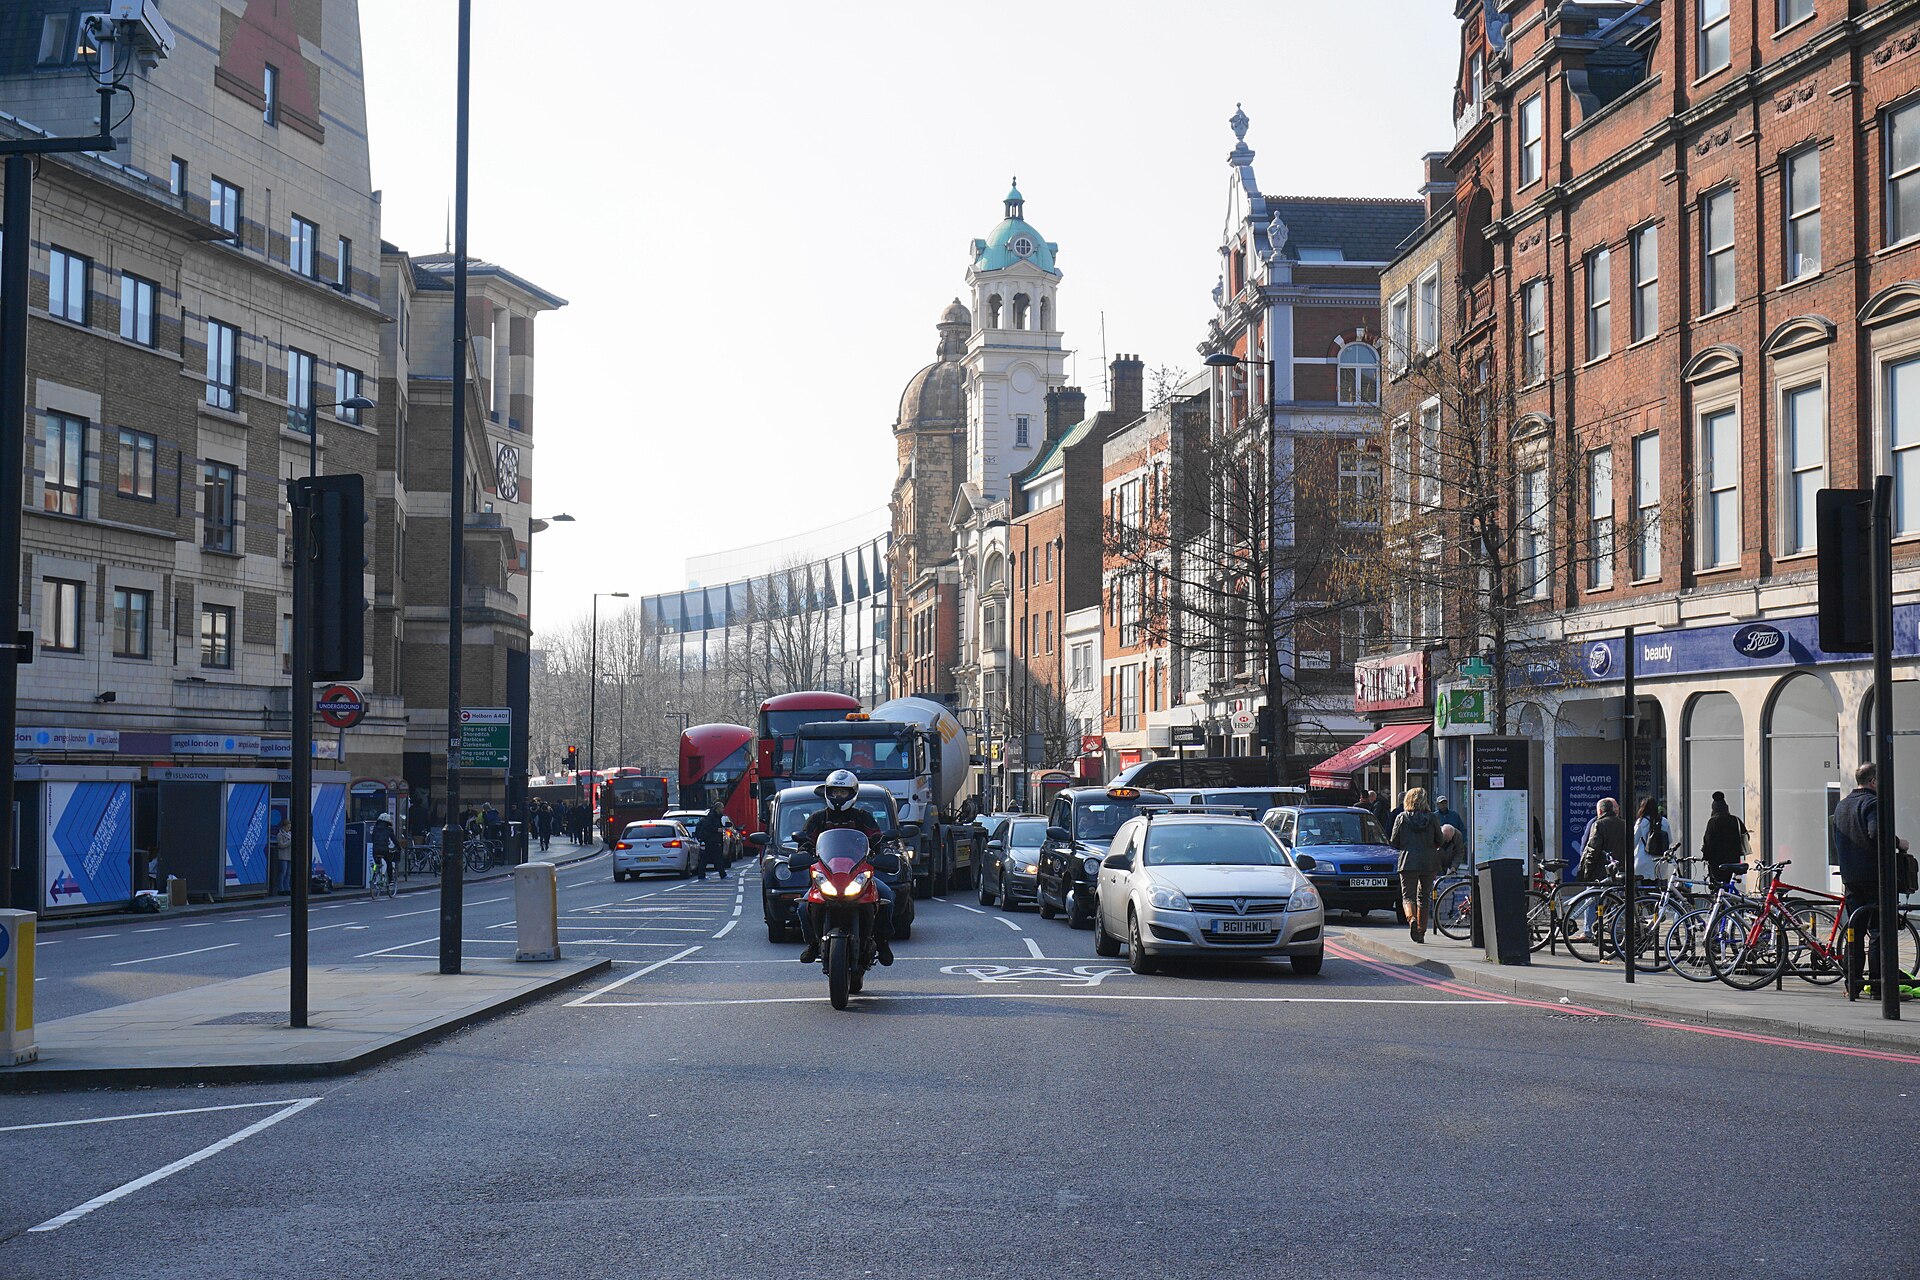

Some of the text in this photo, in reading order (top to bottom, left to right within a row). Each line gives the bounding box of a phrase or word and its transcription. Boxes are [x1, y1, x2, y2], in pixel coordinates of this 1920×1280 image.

[1743, 631, 1779, 651] Boots
[1644, 643, 1672, 663] beauty
[714, 772, 727, 782] 73
[1570, 773, 1612, 783] welcome
[107, 790, 127, 829] BUSINESS
[82, 842, 97, 868] UPPER
[94, 813, 109, 843] STREET
[89, 821, 118, 881] DESIGN CENTRE
[1350, 878, 1370, 886] R847
[1223, 921, 1243, 932] BG11
